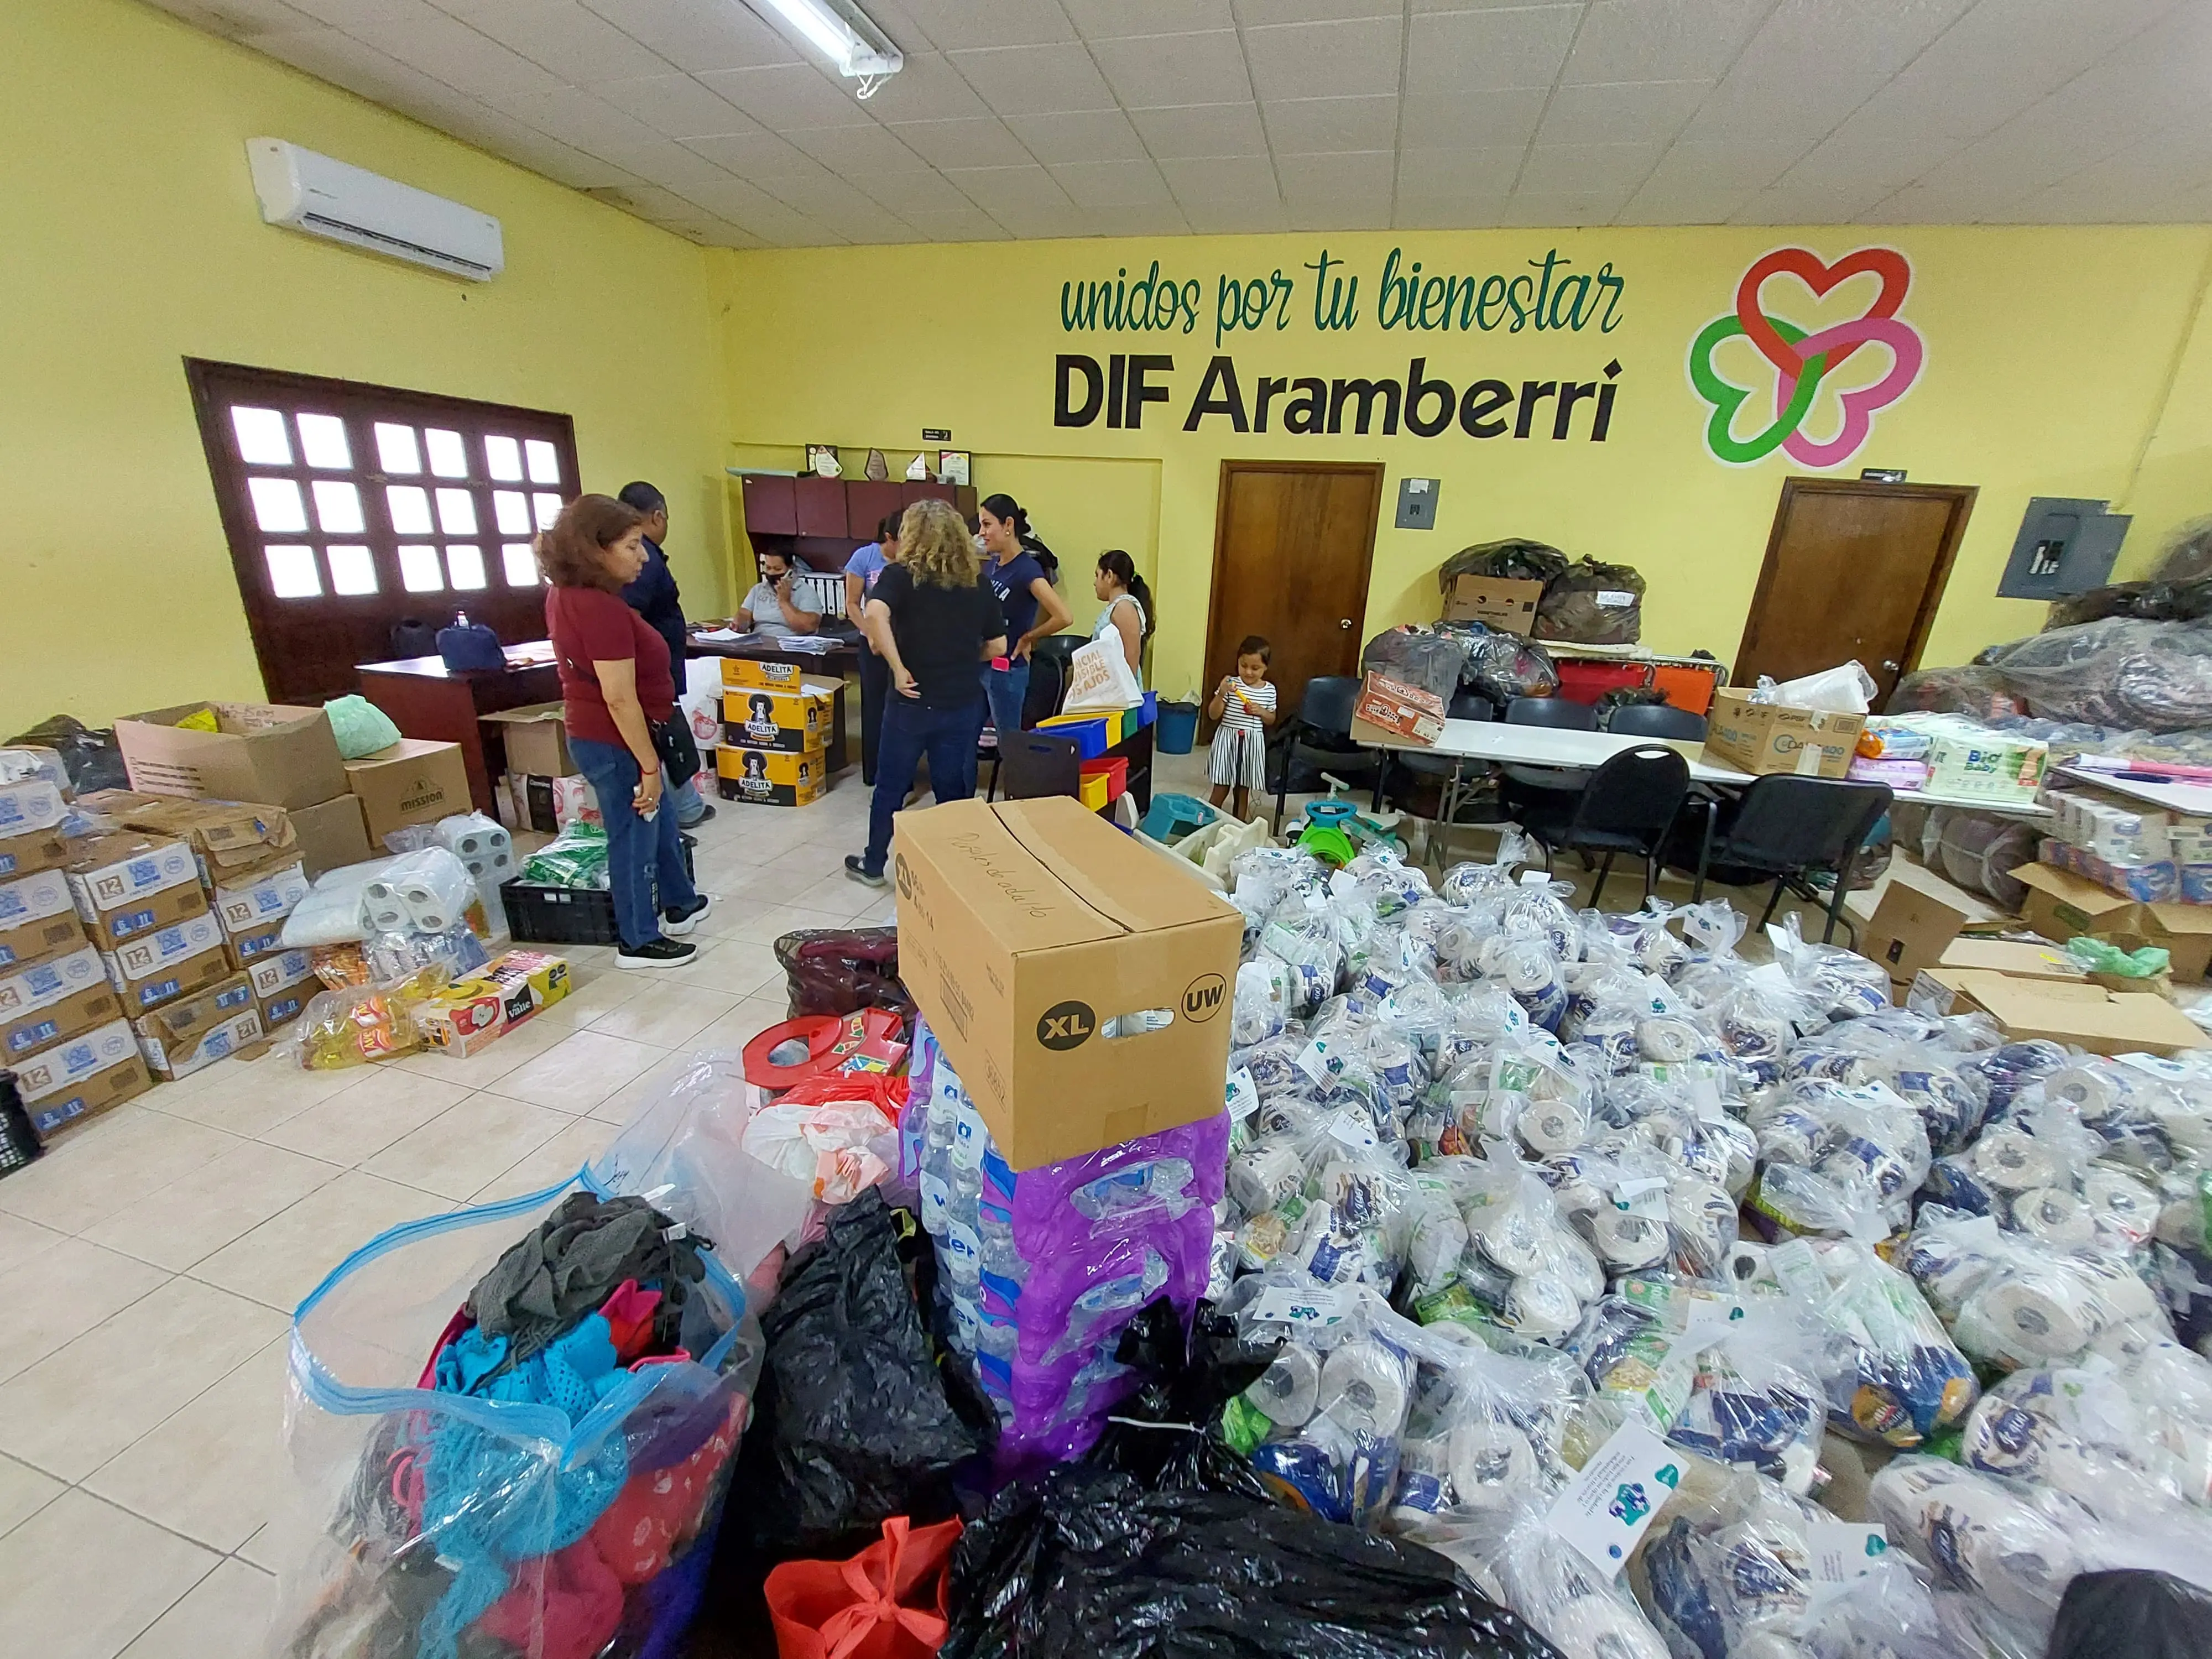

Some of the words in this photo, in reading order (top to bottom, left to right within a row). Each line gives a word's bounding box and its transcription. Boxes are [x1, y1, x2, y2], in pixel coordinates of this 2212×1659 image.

[1061, 260, 1200, 334] unidos
[1216, 269, 1293, 348] por
[1304, 249, 1358, 331] tu
[1378, 247, 1624, 333] bienestar
[1054, 354, 1175, 430] DIF
[1182, 356, 1623, 442] Aramberri
[761, 664, 792, 674] ADELITA
[748, 723, 776, 733] ADELITA
[742, 779, 770, 789] ADELITA
[401, 791, 442, 811] mission
[97, 877, 120, 894] 12
[228, 904, 249, 920] 12
[128, 948, 149, 964] 12
[260, 970, 276, 984] 12
[1186, 984, 1224, 1013] UW
[1045, 1011, 1091, 1040] XL
[24, 1070, 46, 1087] 12
